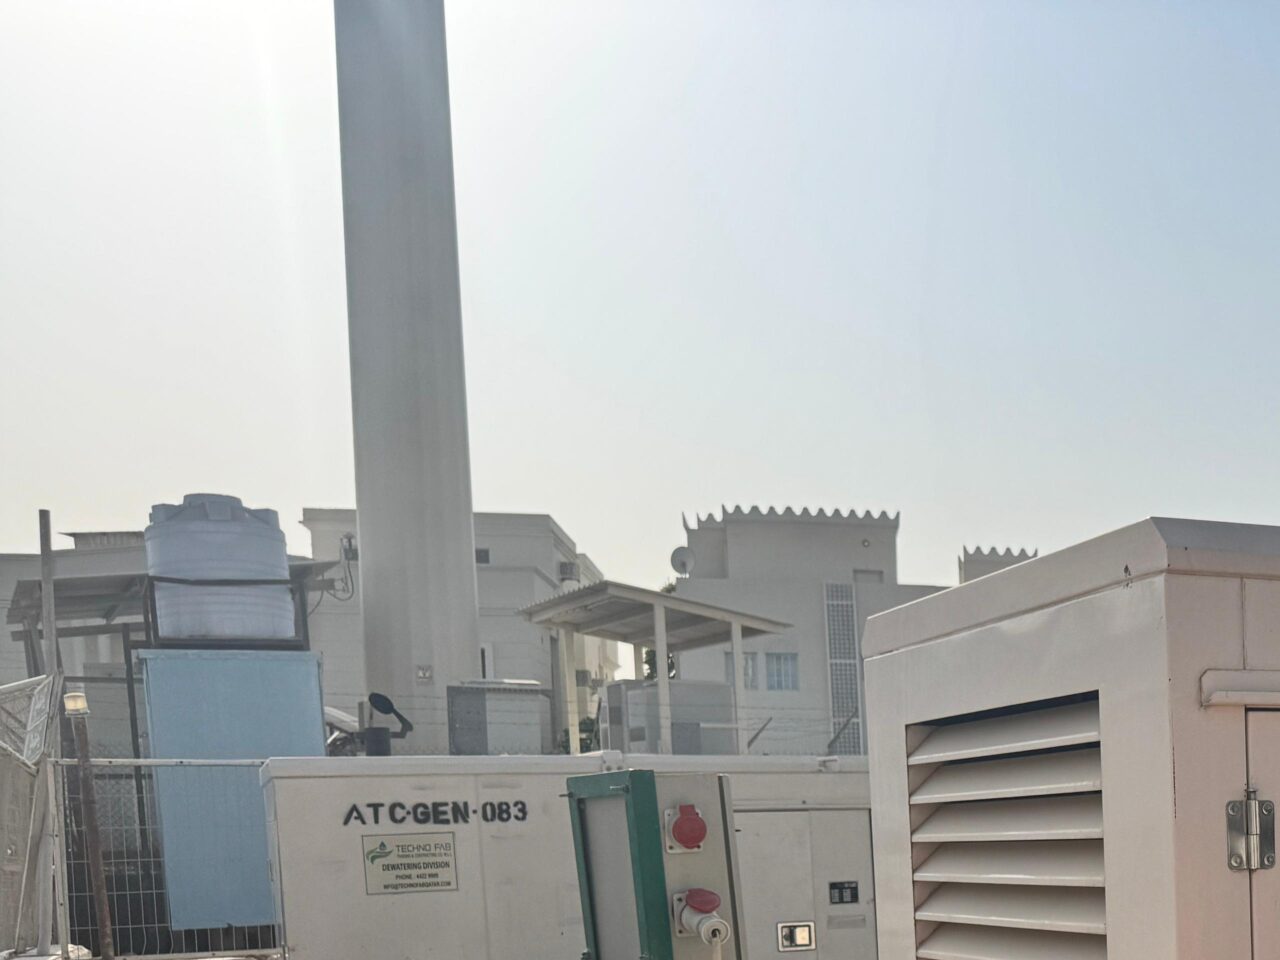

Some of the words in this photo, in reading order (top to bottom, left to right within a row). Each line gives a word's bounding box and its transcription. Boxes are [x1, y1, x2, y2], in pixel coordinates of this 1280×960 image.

[395, 843, 432, 853] TECHNO
[382, 861, 422, 872] DEWATERING
[422, 860, 450, 870] DIVISION
